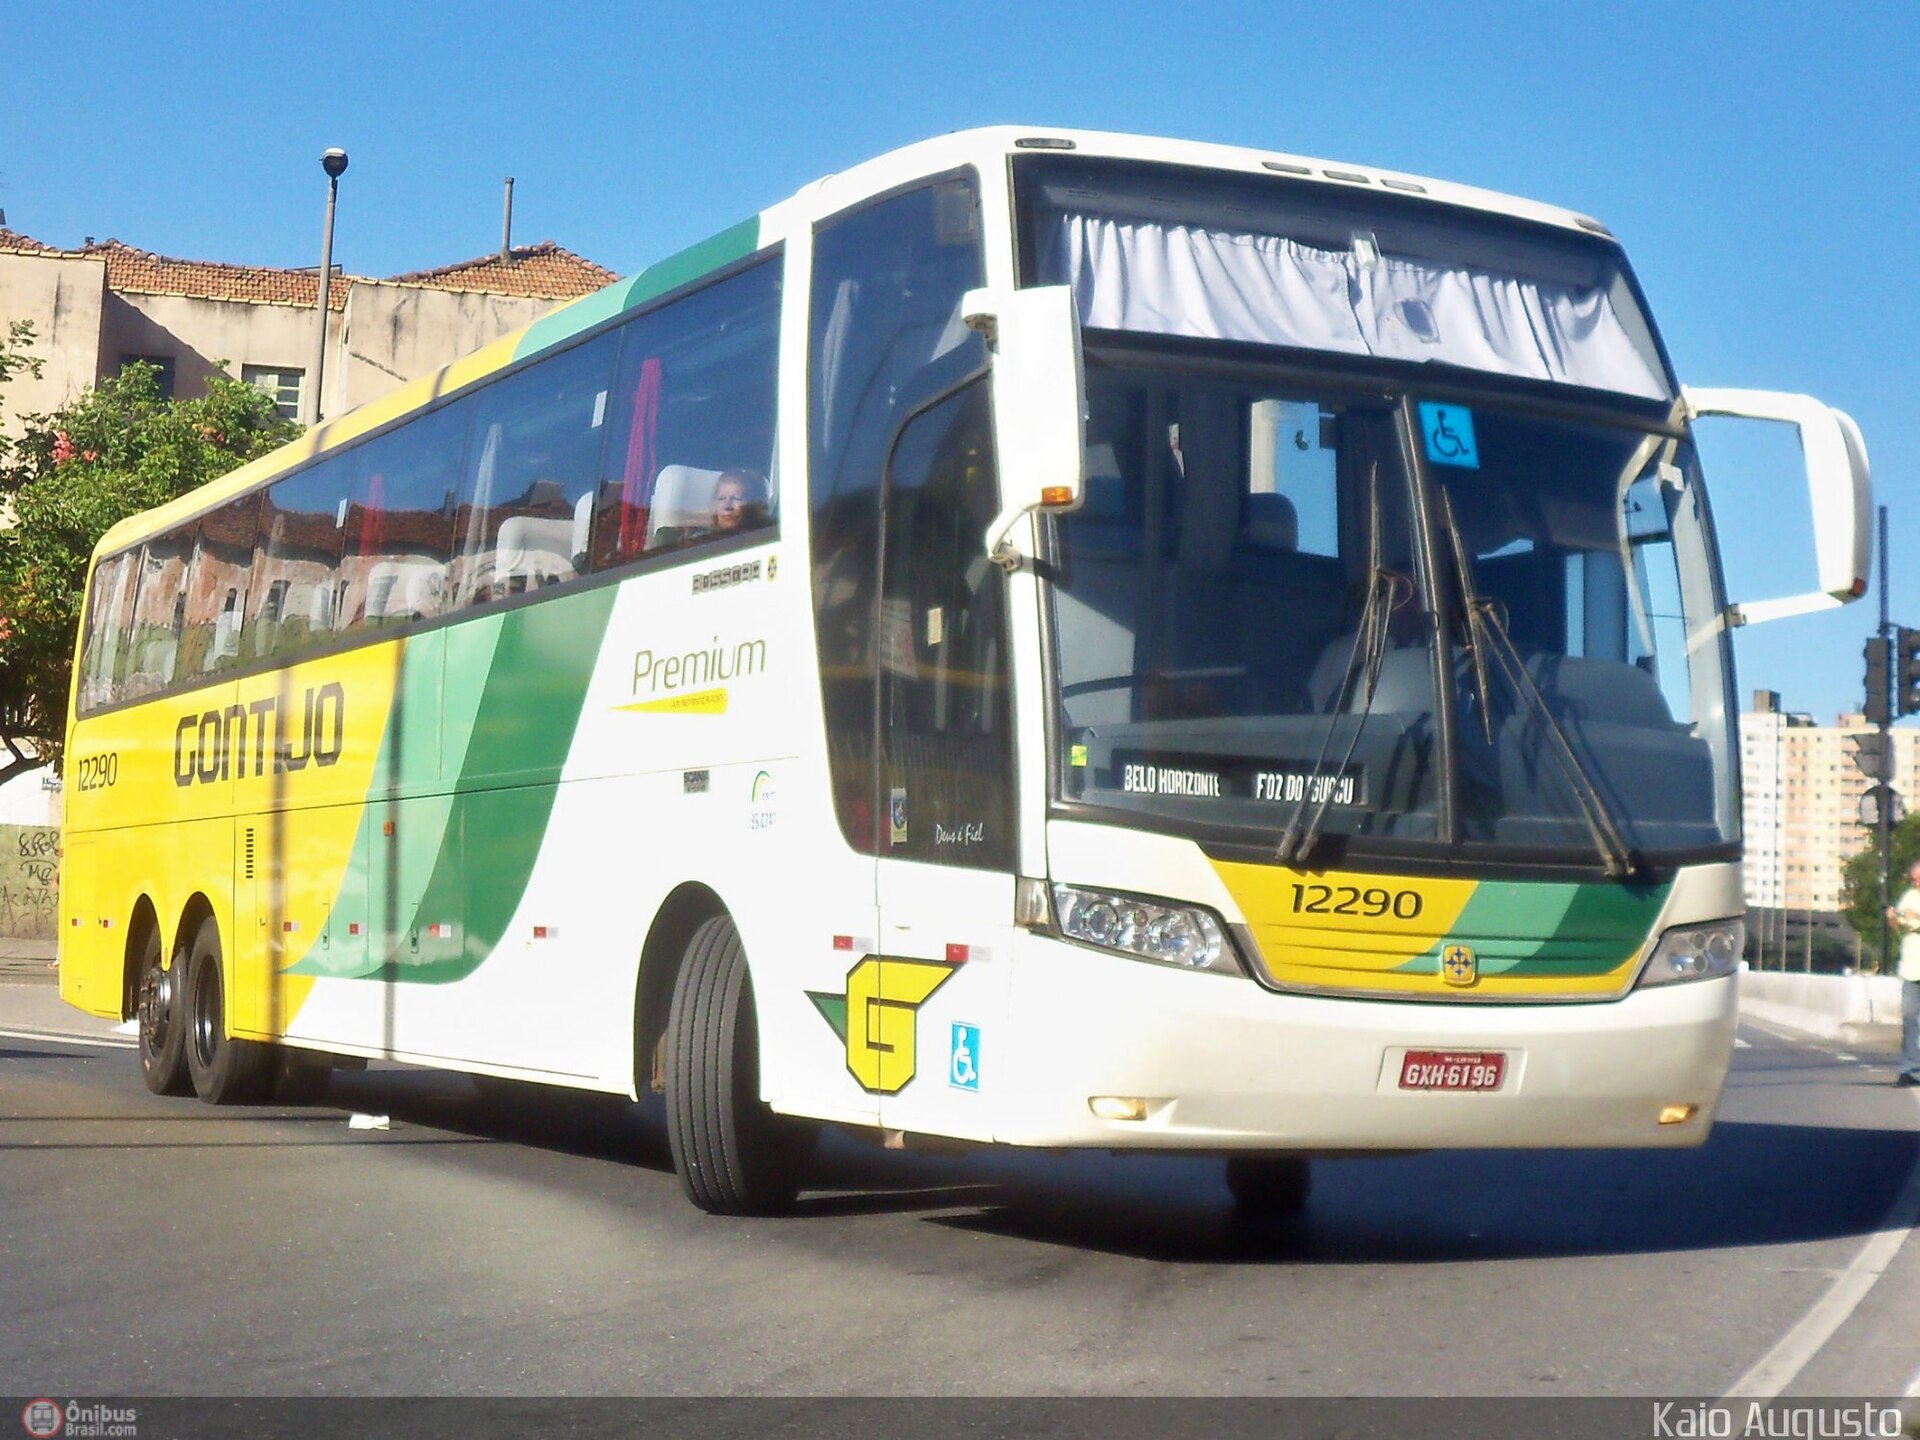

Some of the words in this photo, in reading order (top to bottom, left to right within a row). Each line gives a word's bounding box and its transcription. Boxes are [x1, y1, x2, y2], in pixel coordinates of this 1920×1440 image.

[692, 559, 762, 596] BUSSCAR
[632, 636, 766, 696] Premium
[173, 681, 345, 788] GONTIJO
[77, 752, 118, 792] 12290
[1124, 764, 1156, 793] BELO
[1158, 768, 1221, 798] HORIZONTE
[1256, 772, 1284, 801] FOZ
[1285, 774, 1304, 802] DO
[936, 823, 956, 846] Deus
[965, 821, 985, 847] Fiel
[1291, 883, 1424, 919] 12290
